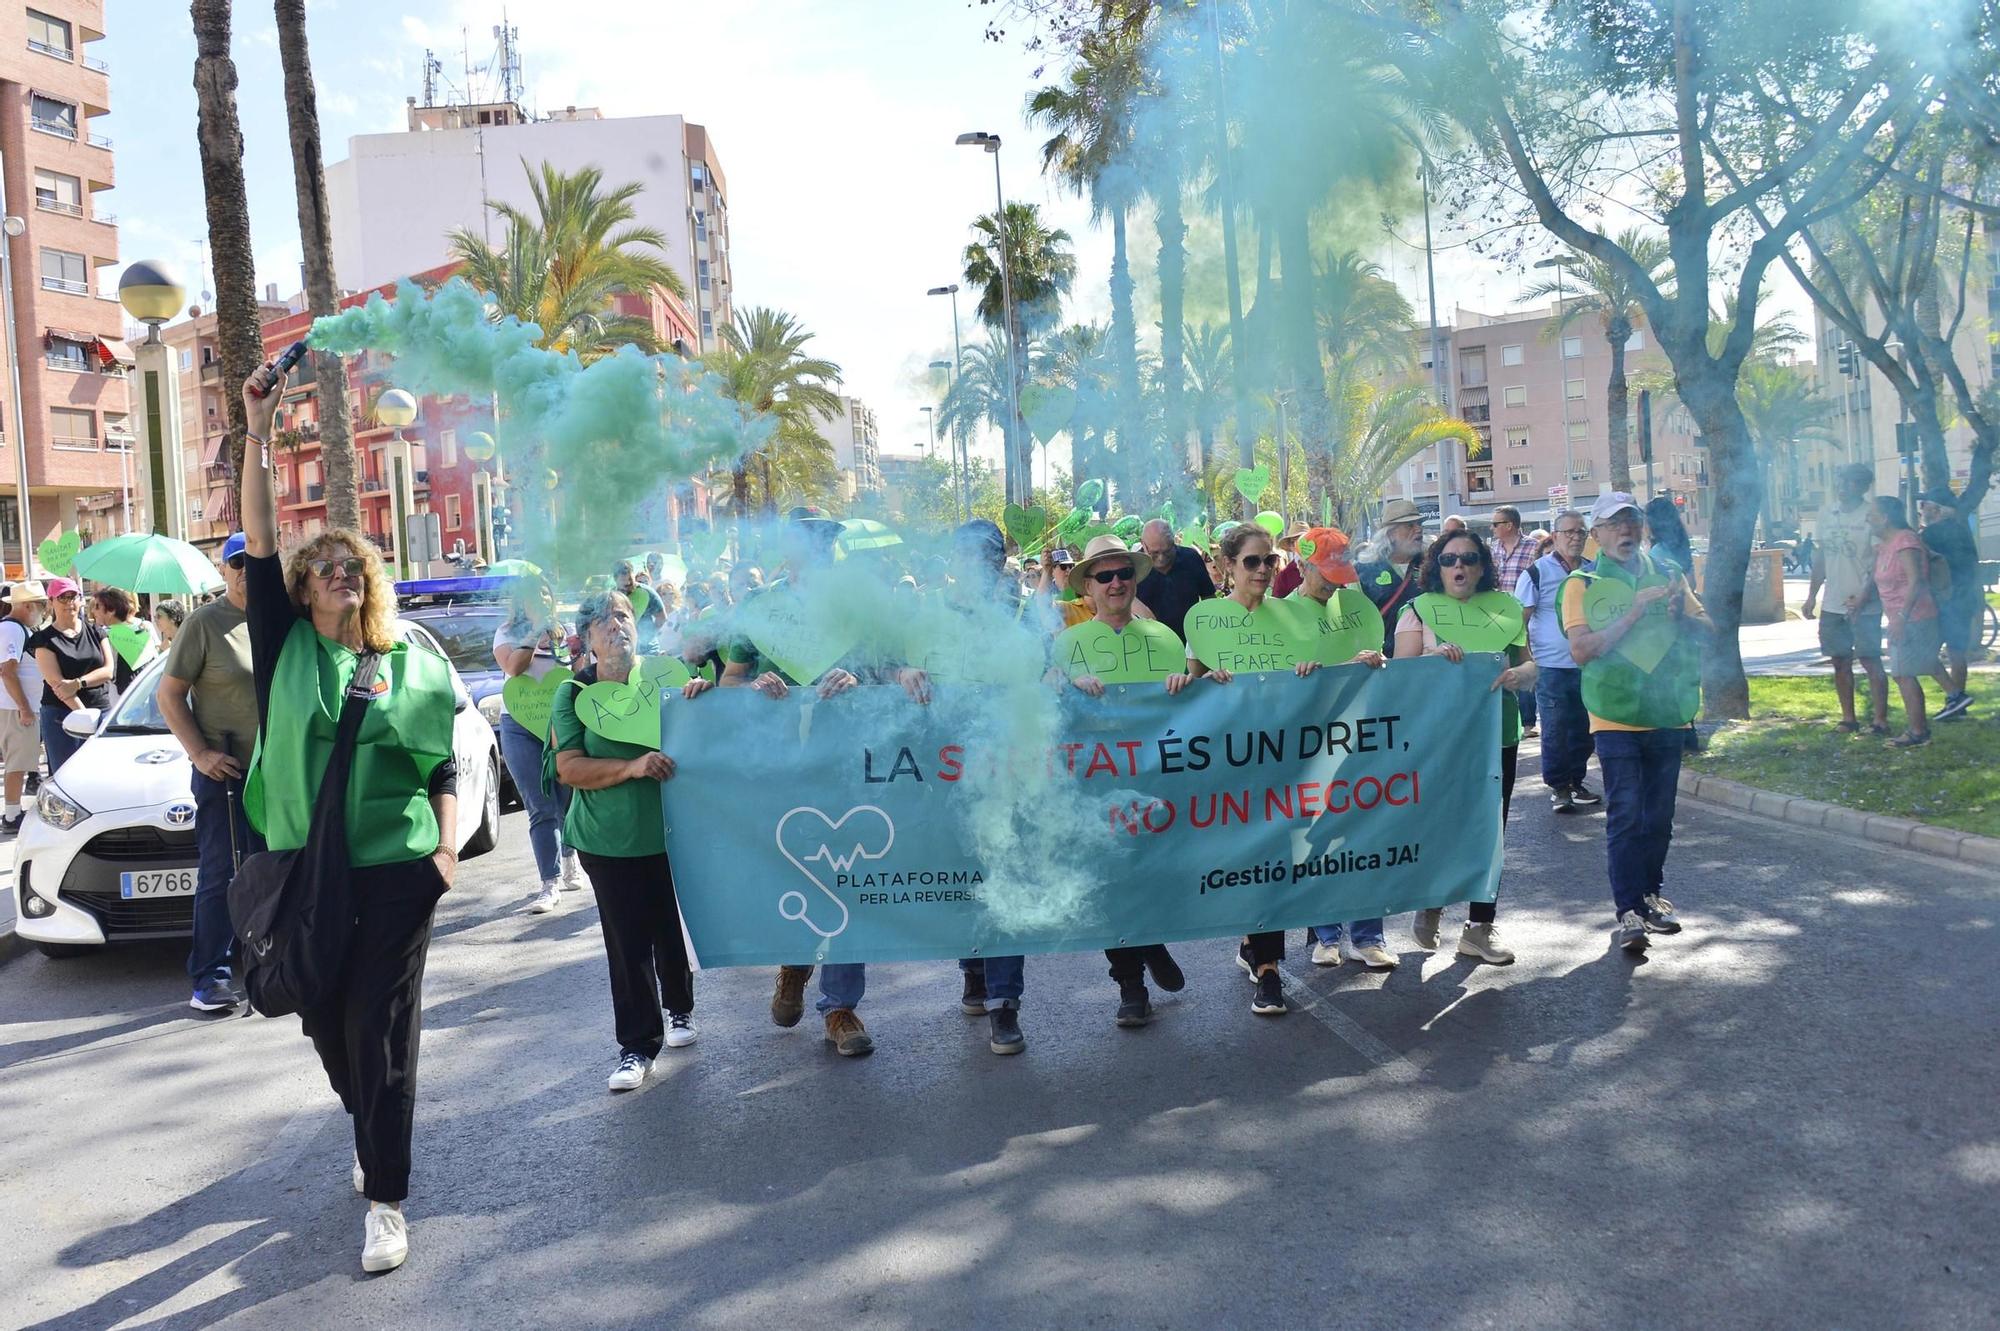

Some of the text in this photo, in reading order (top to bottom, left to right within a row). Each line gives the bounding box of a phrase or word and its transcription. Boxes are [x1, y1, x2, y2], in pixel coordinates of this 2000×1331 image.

[1432, 604, 1505, 632] ELX
[1070, 633, 1169, 675] ASPE
[1237, 633, 1285, 647] DELS
[864, 747, 924, 783] LA
[1158, 729, 1211, 774] ÉS
[1226, 729, 1285, 768] UN
[1299, 715, 1409, 760] DRET,
[1109, 770, 1421, 837] NO UN NEGOCI
[137, 872, 192, 893] 6766
[836, 870, 984, 888] PLATAFORMA
[1200, 843, 1420, 894] ¡Gestió pública JA!
[859, 893, 889, 905] PER
[893, 892, 911, 904] LA
